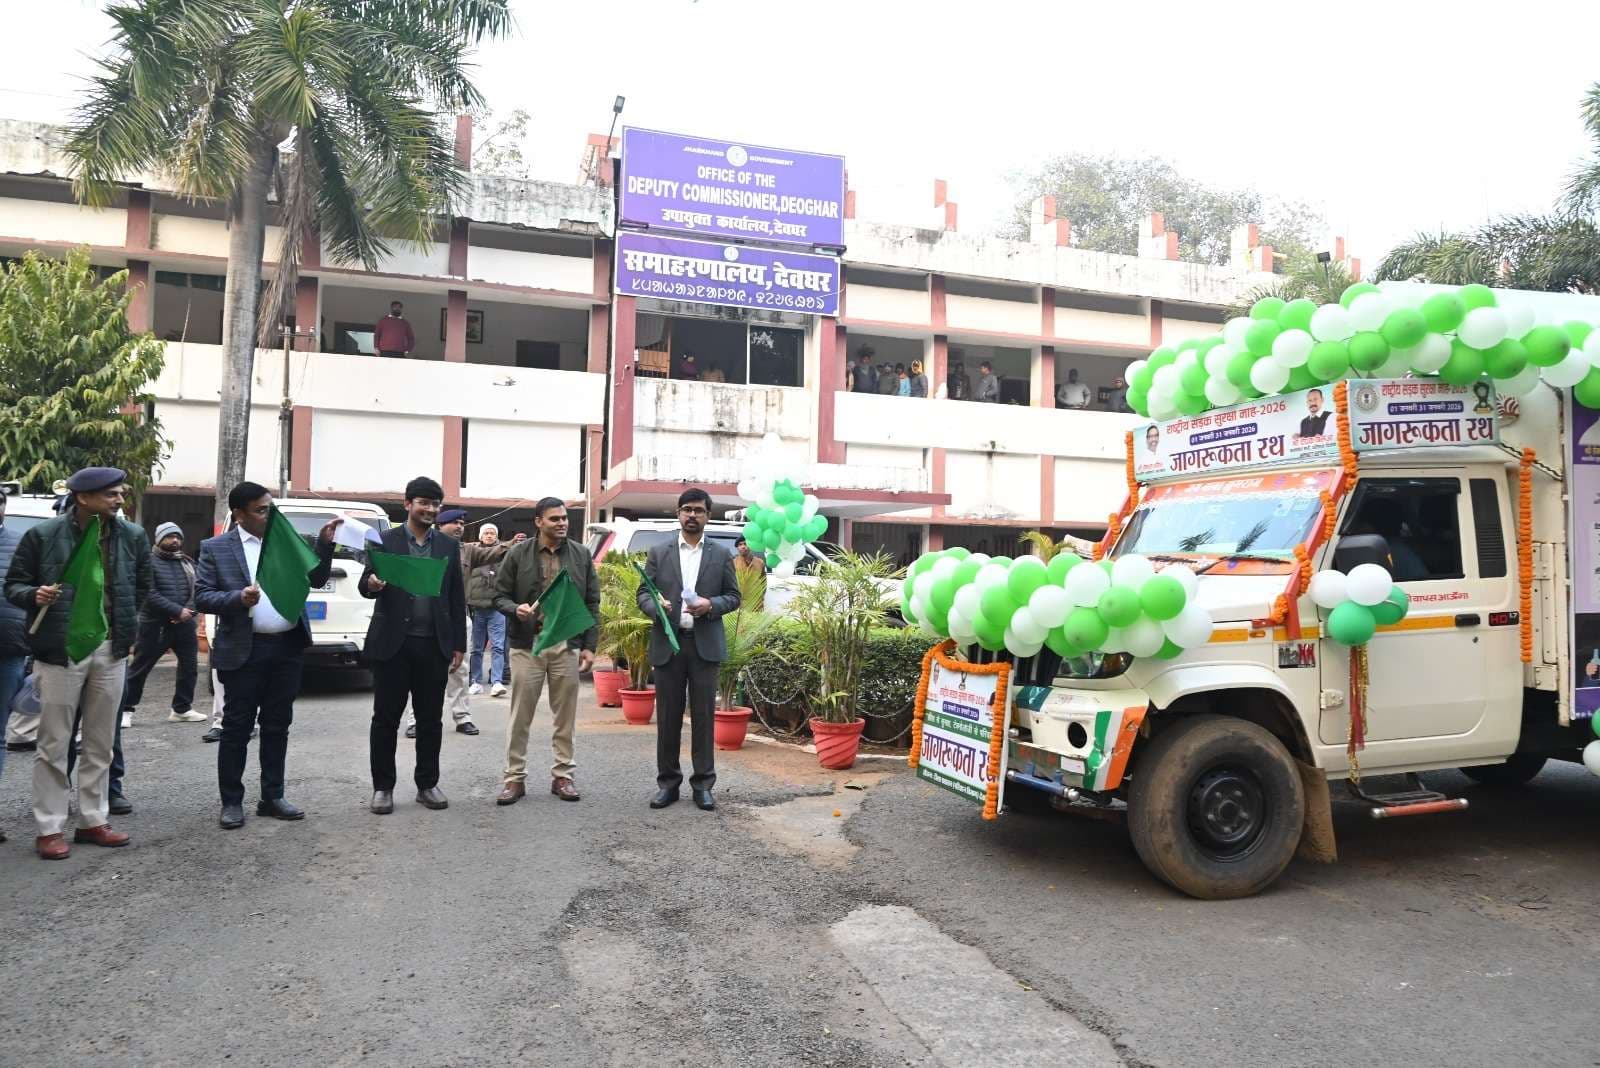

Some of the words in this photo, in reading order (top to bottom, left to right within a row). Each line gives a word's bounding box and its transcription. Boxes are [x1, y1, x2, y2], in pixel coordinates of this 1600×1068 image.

[628, 176, 679, 198] DEPUTY
[697, 165, 735, 183] OFFICE
[738, 171, 752, 185] OF
[755, 173, 776, 188] THE
[661, 208, 712, 228] उपायुक्त
[1166, 418, 1189, 435] राष्ट्रीय
[1191, 415, 1212, 430] सड़क
[1214, 411, 1237, 427] सुरक्षा
[1241, 425, 1256, 435] 2026
[1358, 419, 1460, 446] जागरूकता
[1466, 417, 1494, 441] रथ
[1169, 441, 1252, 472] जागरूकता
[1258, 434, 1285, 460] रथ
[1490, 614, 1509, 625] HD
[921, 731, 977, 779] जागरूकता
